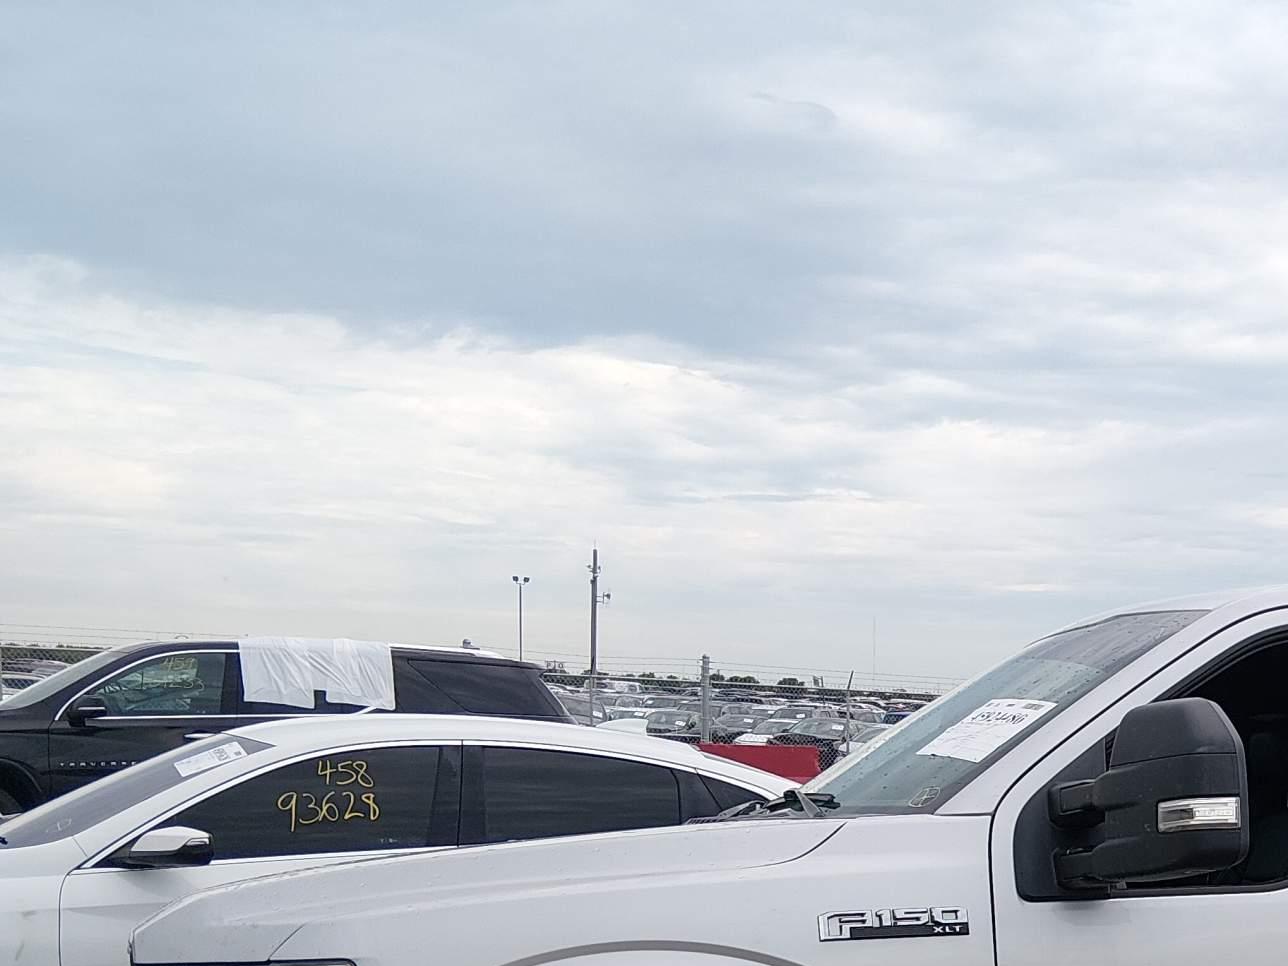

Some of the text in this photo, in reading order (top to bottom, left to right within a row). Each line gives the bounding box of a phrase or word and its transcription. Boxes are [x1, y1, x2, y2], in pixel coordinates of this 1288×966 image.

[317, 759, 374, 788] 458
[277, 791, 381, 832] 93628
[933, 925, 963, 933] XLT
